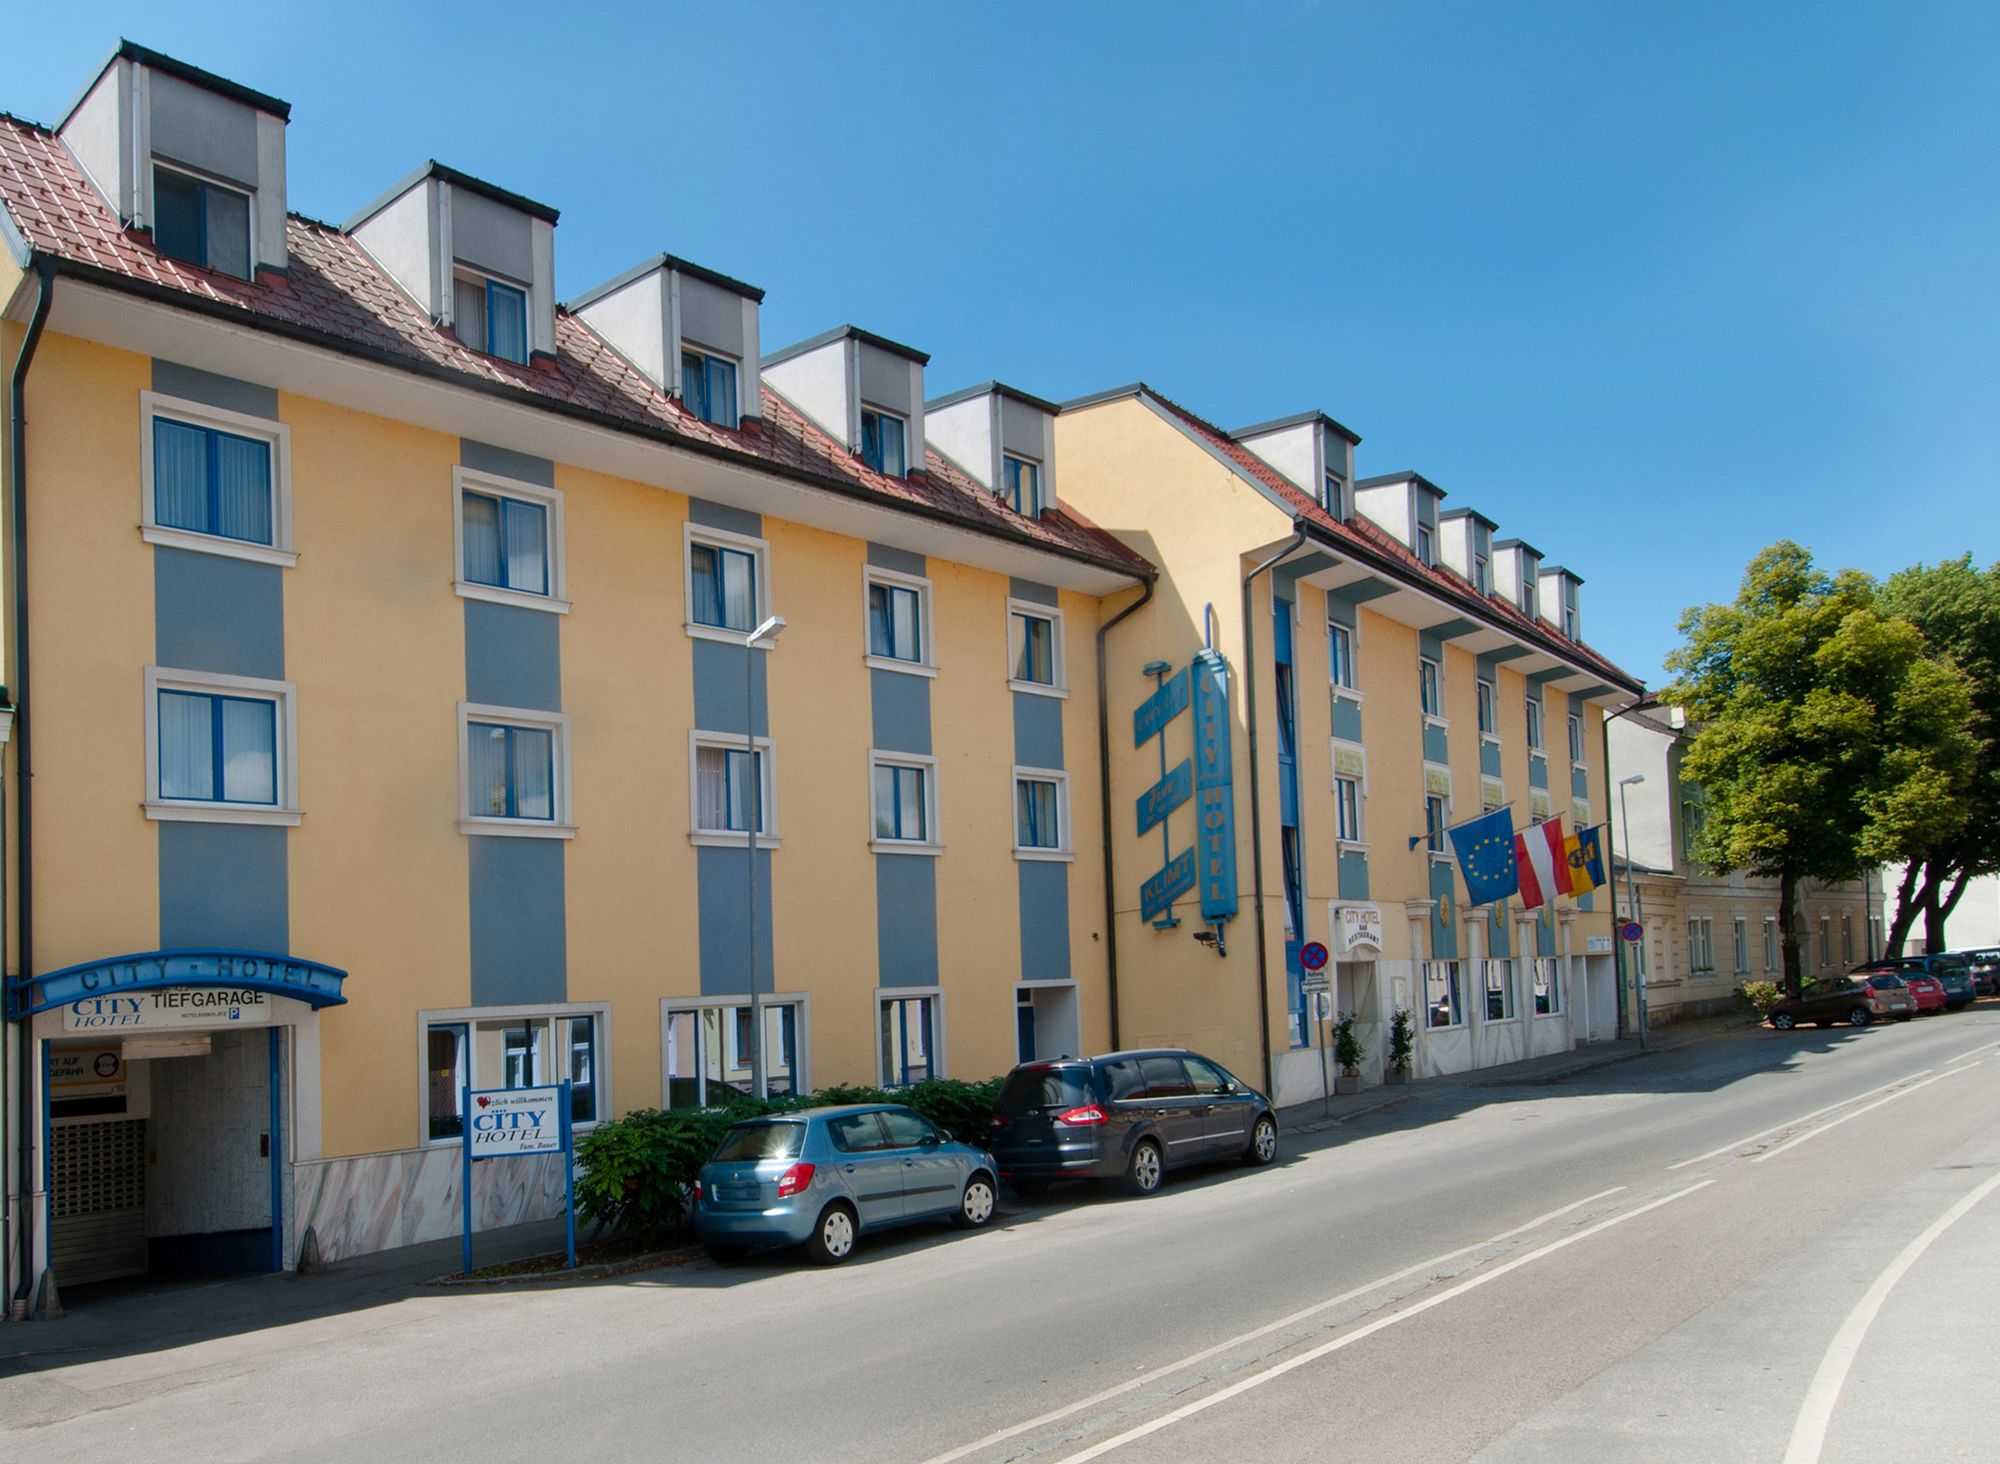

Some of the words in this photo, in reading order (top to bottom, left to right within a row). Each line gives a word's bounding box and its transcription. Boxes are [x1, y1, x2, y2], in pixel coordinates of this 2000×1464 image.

[1201, 675, 1219, 764] CITY
[1205, 787, 1226, 901] HOTEL
[1346, 910, 1359, 924] CITY
[1360, 910, 1380, 924] HOTEL
[81, 958, 169, 990] CITY
[217, 957, 320, 990] HOTEL
[72, 997, 146, 1016] CITY
[150, 989, 265, 1009] TIEFGARAGE
[74, 1014, 146, 1028] HOTEL
[473, 1110, 546, 1131] CITY
[475, 1129, 545, 1143] HOTEL
